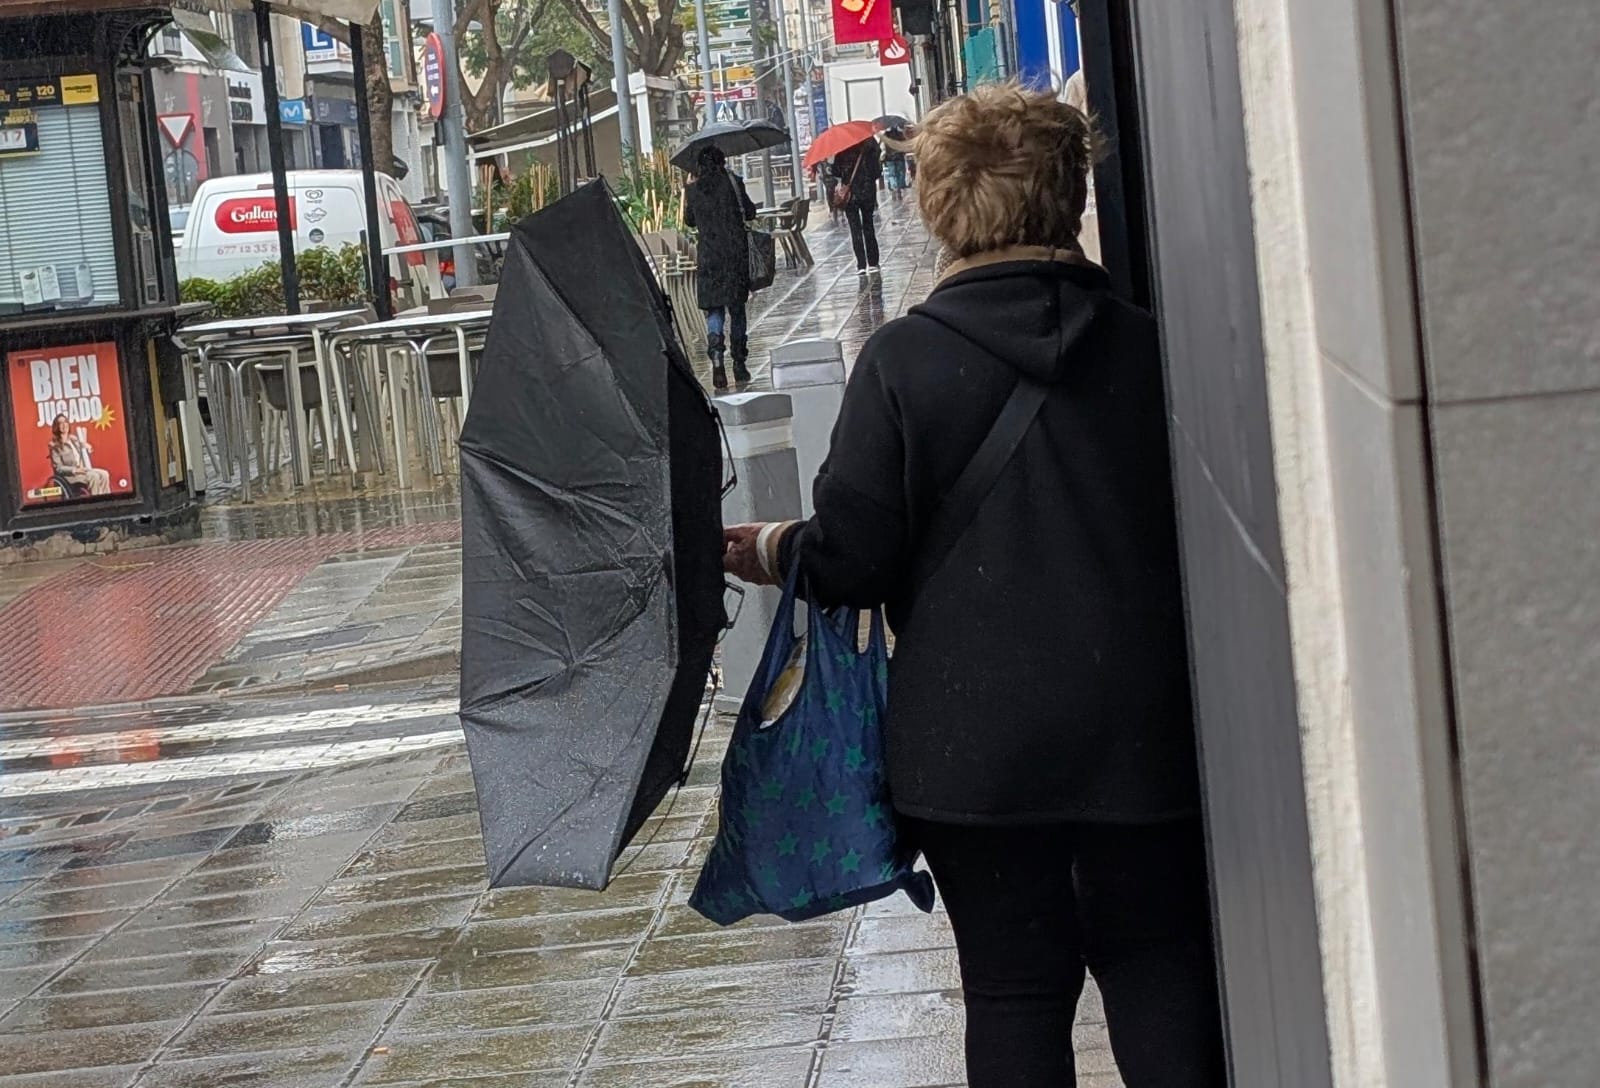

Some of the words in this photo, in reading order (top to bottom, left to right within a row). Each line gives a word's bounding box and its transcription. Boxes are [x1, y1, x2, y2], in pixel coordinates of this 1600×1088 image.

[35, 85, 55, 96] 120
[217, 245, 237, 256] 677
[239, 245, 251, 254] 12
[253, 244, 268, 254] 35
[30, 354, 101, 402] BIEN
[37, 396, 103, 427] JUGADO
